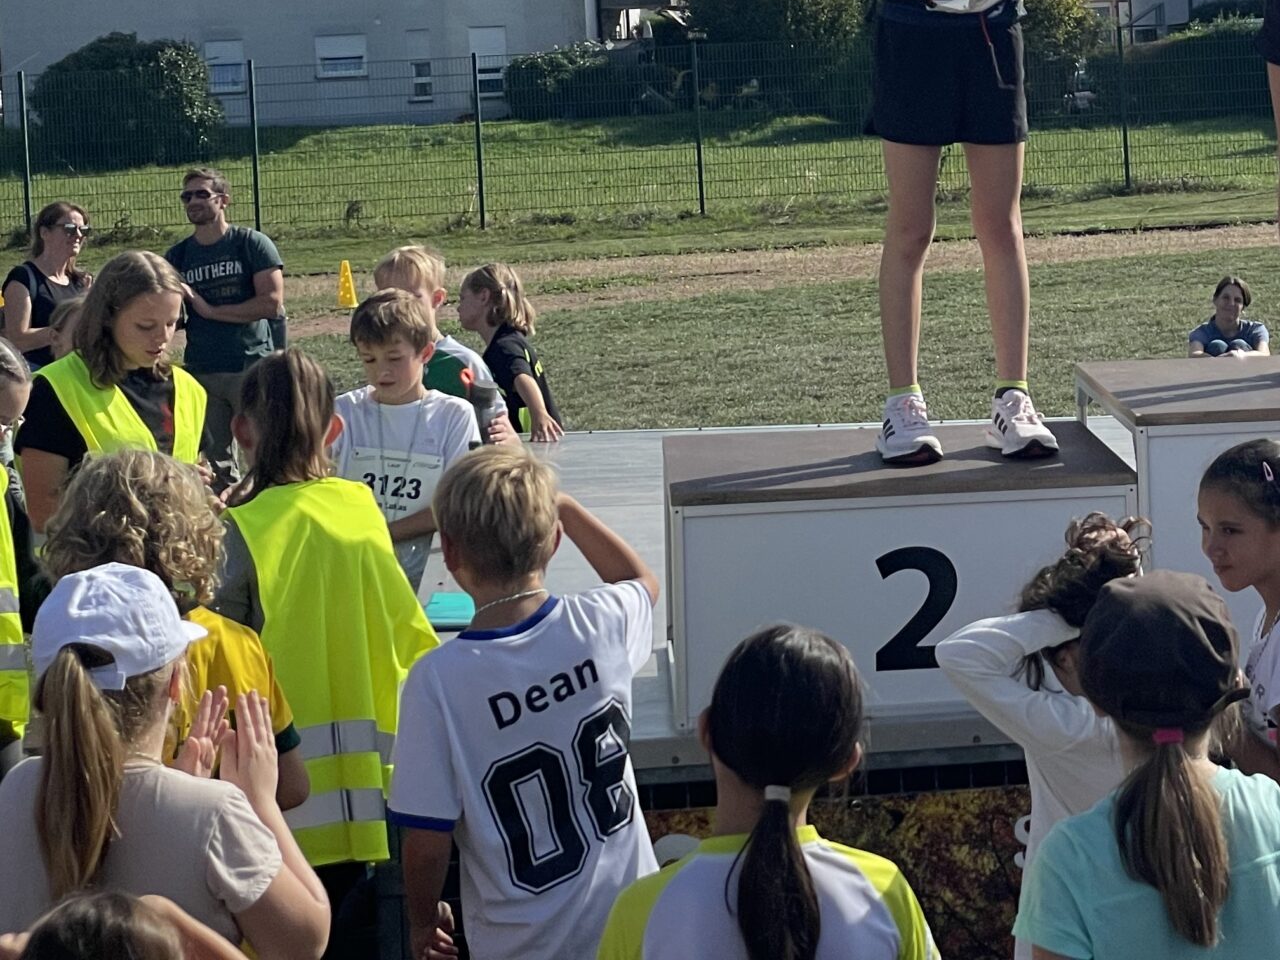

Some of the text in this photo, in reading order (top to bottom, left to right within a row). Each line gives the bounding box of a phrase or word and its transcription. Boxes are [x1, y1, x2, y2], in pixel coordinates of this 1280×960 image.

[363, 472, 422, 500] 3123
[875, 546, 958, 672] 2
[488, 658, 600, 730] Dean
[481, 697, 634, 896] 08
